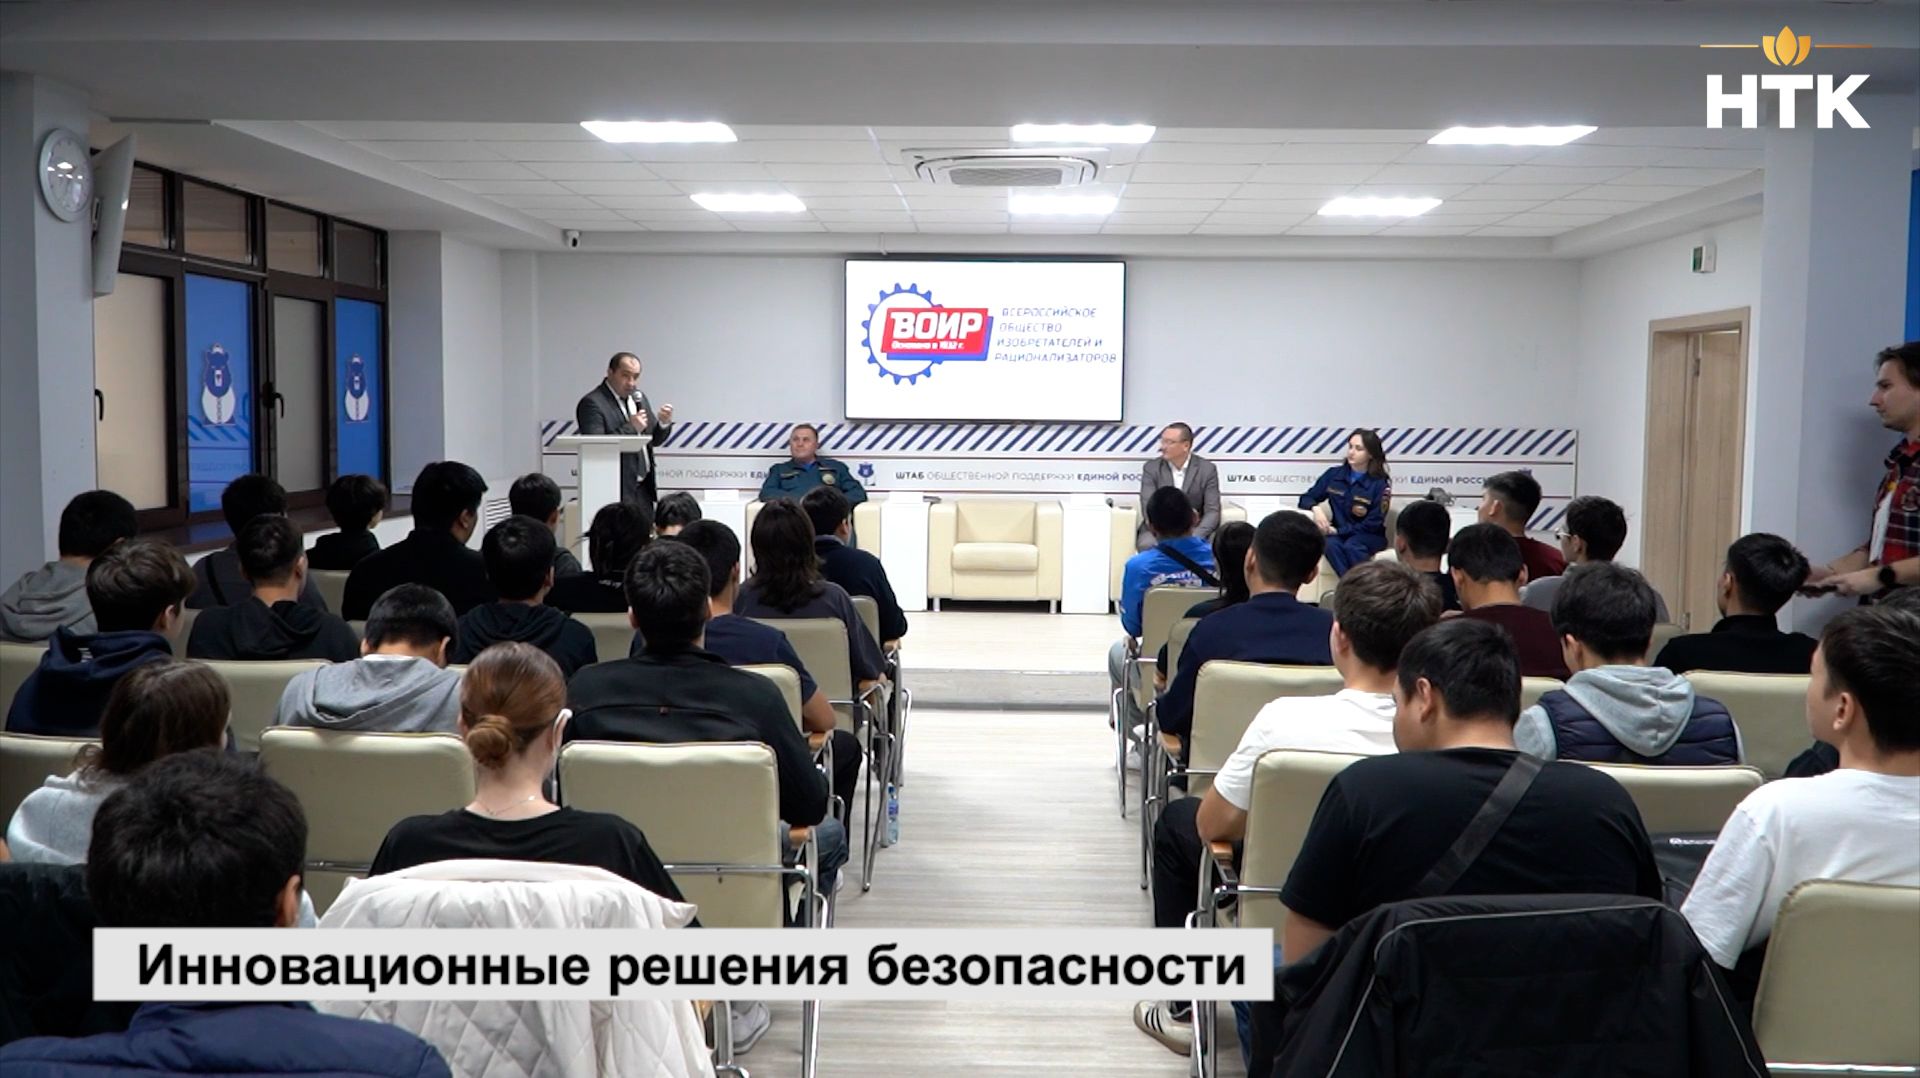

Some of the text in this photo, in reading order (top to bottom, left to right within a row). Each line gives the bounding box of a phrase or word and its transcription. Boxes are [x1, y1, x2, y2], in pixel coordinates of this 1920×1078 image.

[1001, 305, 1097, 318] ВСЕРОССИЙСКОЕ
[890, 311, 983, 340] ВОИР
[999, 322, 1063, 333] ОБЩЕСТВО
[996, 336, 1103, 348] ИЗОБРЕТАТЕЛЕЙ И
[994, 352, 1117, 363] РАЦИОНАЛИЗАТОРОВ
[895, 470, 1143, 482] ШТАБ ОБЩЕСТВЕННОЙ ПОДДЕРЖКИ ЕДИНОЙ РОС
[1227, 474, 1257, 483] ШТАБ
[1410, 474, 1454, 484] ЕДИНОЙ
